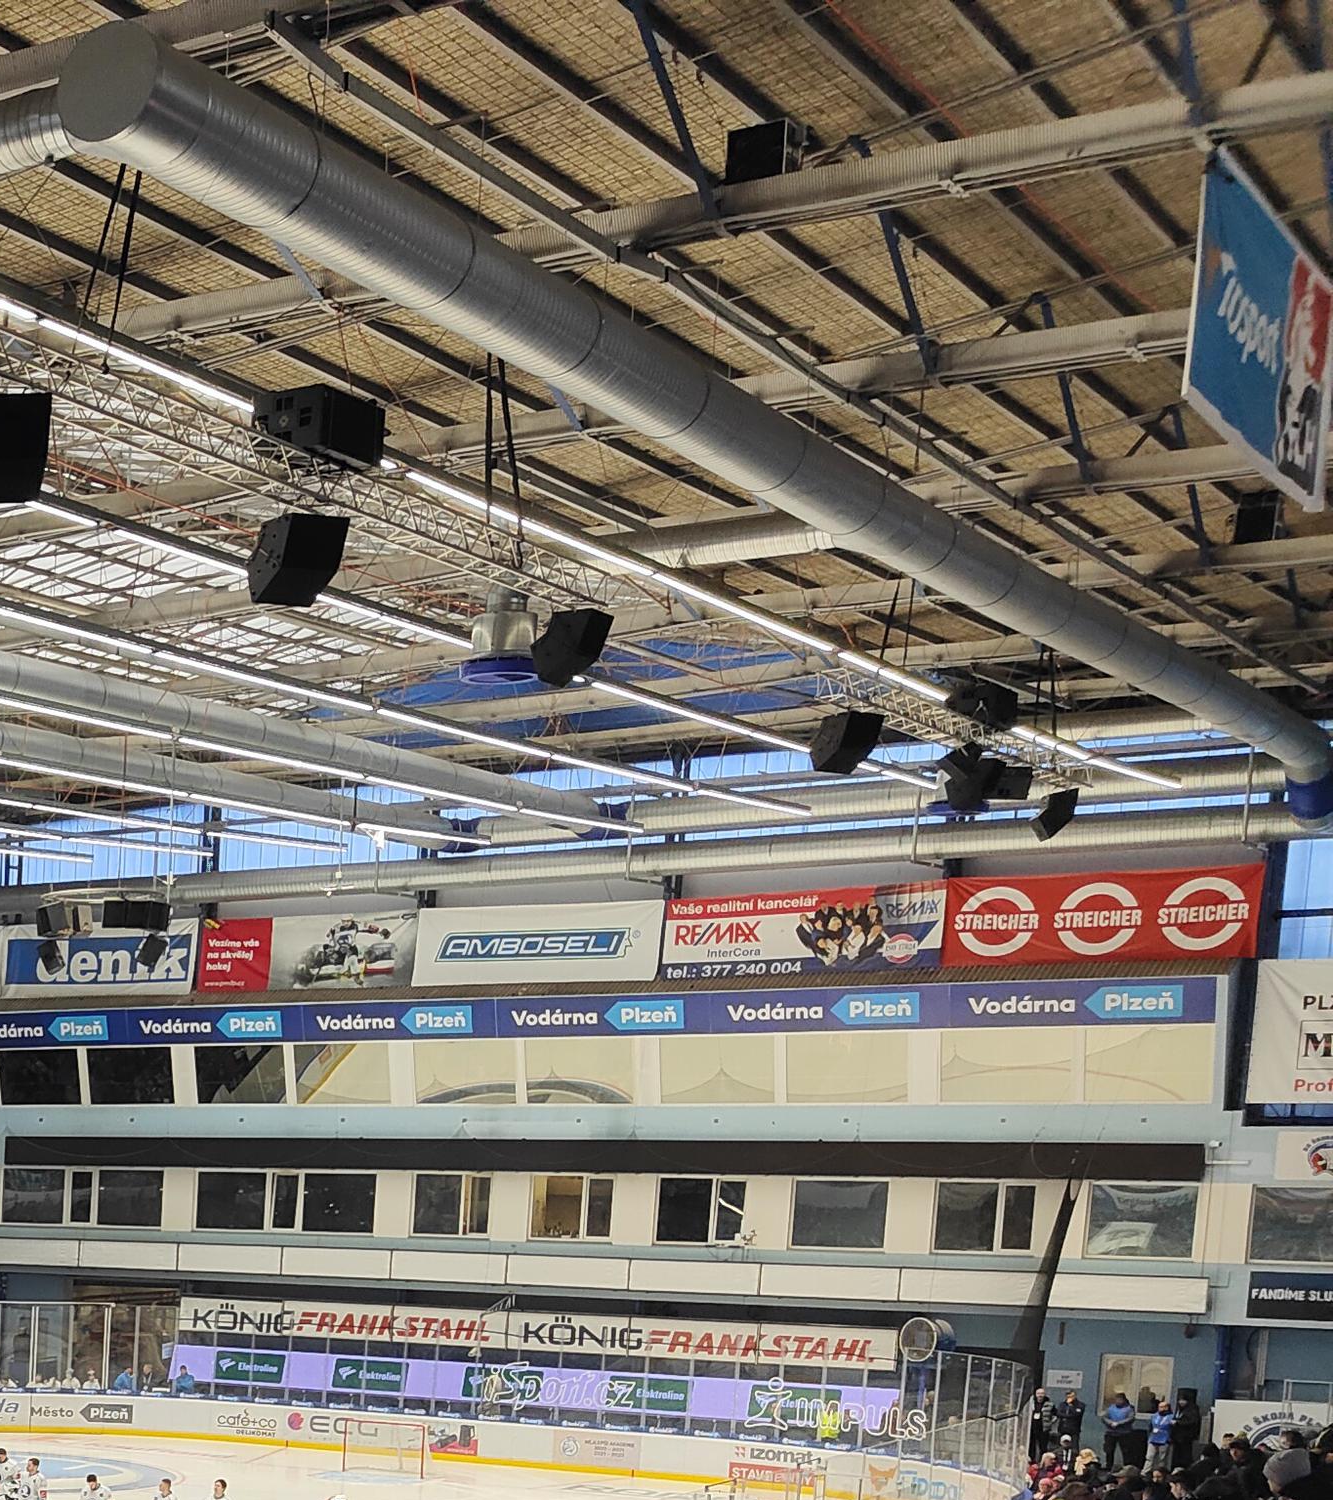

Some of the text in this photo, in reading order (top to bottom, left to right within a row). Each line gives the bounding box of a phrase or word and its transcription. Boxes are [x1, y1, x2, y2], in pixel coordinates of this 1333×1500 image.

[671, 895, 819, 915] Vaše realitní kancelář
[1157, 903, 1250, 925] STREICHER
[954, 913, 1039, 930] STREICHER
[1053, 909, 1142, 929] STREICHER
[674, 920, 762, 946] RE/MAX
[445, 934, 619, 957] AMBOSELI
[706, 947, 761, 958] InterCora
[36, 946, 188, 983] denk
[666, 961, 802, 979] tel.: 377 240 004
[727, 998, 912, 1021] Vodárna Plzeň
[968, 991, 1174, 1015] Vodárna Plzeň
[139, 1014, 277, 1035] Vodárna Plzeň
[316, 1011, 466, 1031] Vodárna Plzeň
[511, 1003, 677, 1026] Vodárna Plzeň
[60, 1019, 103, 1037] Plzeň
[1251, 1285, 1306, 1302] FANDÍME
[192, 1302, 295, 1334] KÖNIG
[522, 1316, 643, 1350] KÖNIG
[31, 1405, 129, 1421] Město Plzeň
[795, 1396, 927, 1441] IMPULS
